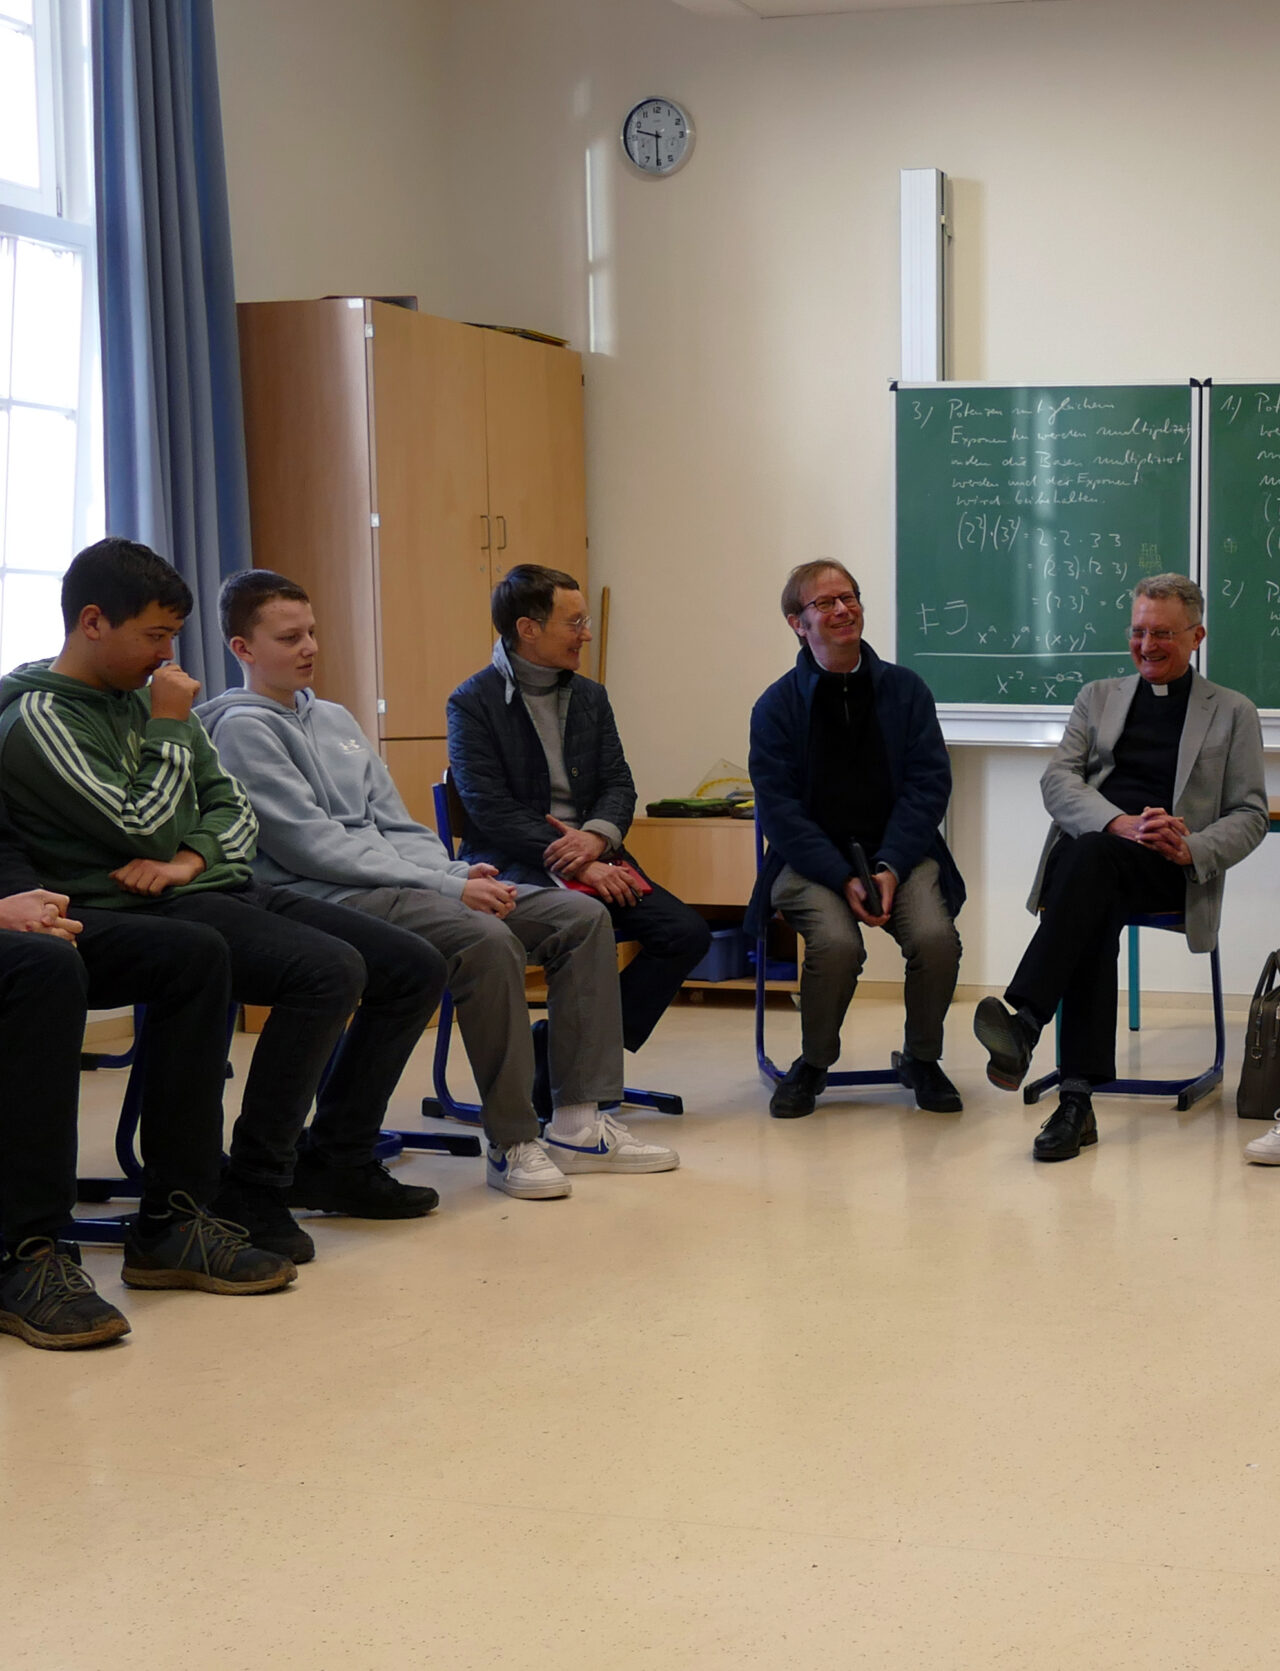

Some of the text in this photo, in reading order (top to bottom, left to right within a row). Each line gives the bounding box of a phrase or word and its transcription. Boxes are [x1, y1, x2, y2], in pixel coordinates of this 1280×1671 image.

[653, 106, 661, 114] 12
[948, 398, 1003, 420] Potenzen
[1037, 430, 1087, 441] werden
[1001, 456, 1027, 467] die
[952, 477, 999, 489] werden
[1007, 475, 1038, 487] und
[1077, 471, 1139, 490] Exponent
[956, 495, 1001, 506] wird
